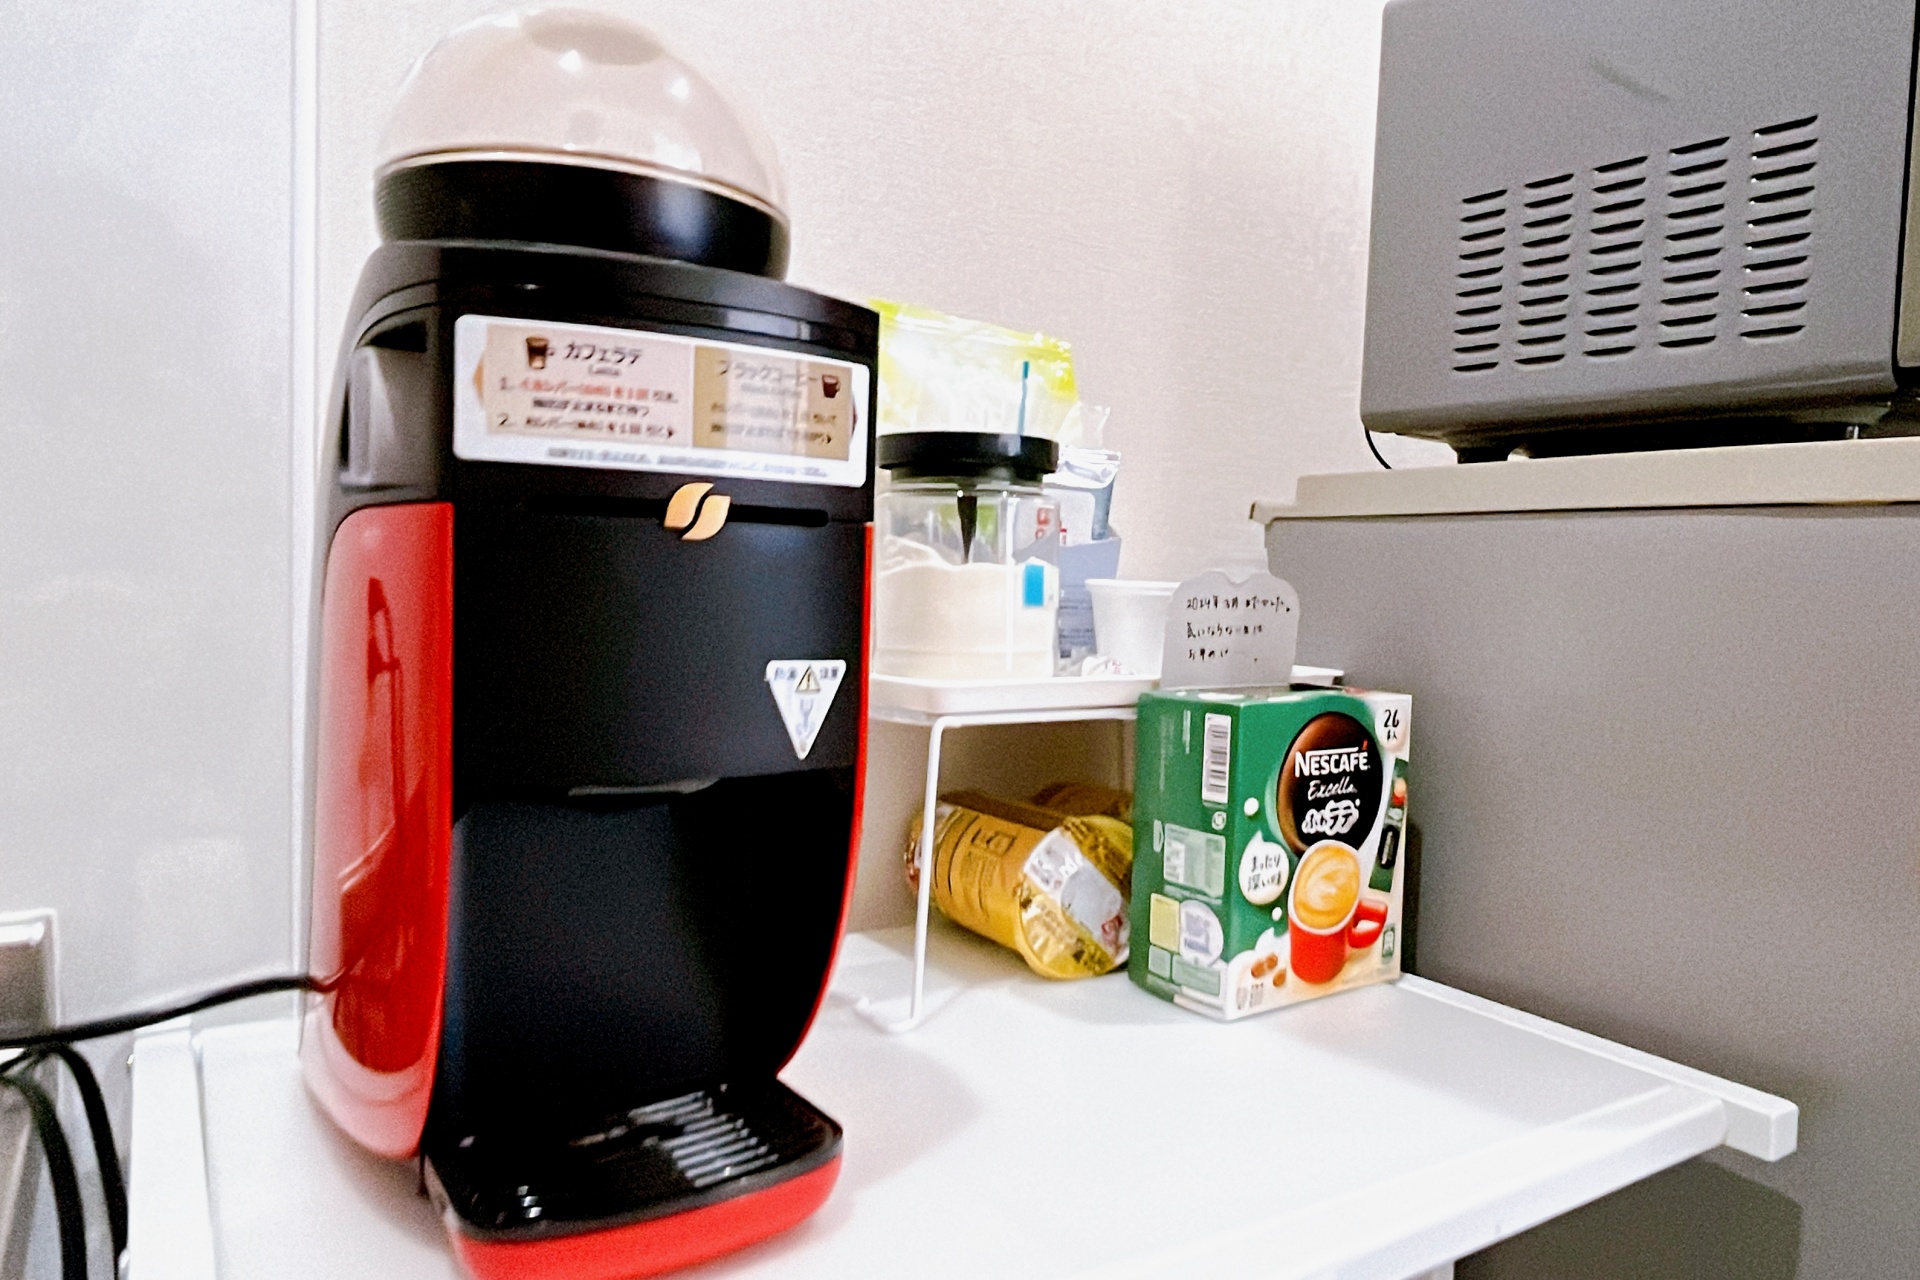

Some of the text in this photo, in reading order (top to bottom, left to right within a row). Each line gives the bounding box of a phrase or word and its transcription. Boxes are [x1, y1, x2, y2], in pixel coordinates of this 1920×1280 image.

[564, 342, 643, 365] カフェラテ
[1384, 709, 1400, 728] 26
[1307, 776, 1357, 800] Excella
